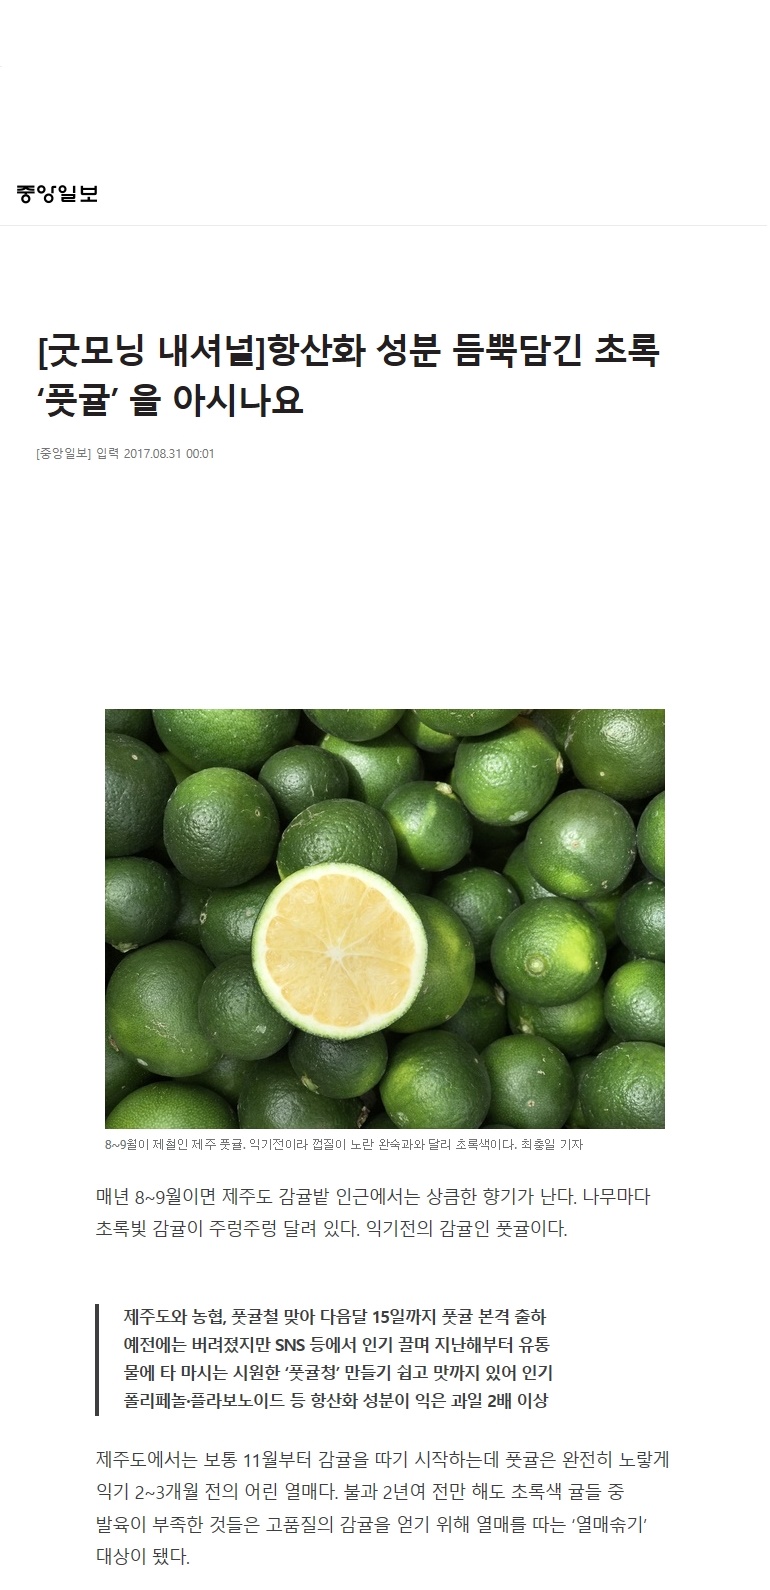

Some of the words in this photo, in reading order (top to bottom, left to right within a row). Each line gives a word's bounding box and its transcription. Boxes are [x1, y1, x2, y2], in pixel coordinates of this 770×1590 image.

[16, 184, 98, 205] 중앙일보
[38, 333, 144, 371] [굿모닝
[159, 333, 367, 371] 내셔널]항산화
[375, 333, 442, 368] 성분
[452, 333, 582, 369] 듬뿍담긴
[594, 333, 661, 368] 초록
[129, 383, 162, 417] 을
[173, 383, 304, 418] 아시나요
[36, 447, 91, 461] [중앙일보]
[96, 447, 119, 460] 입력
[123, 448, 181, 459] 2017.08.31
[186, 448, 214, 459] 00:01
[96, 1187, 129, 1206] 매년
[134, 1187, 216, 1206] 8~9월이면
[222, 1187, 273, 1206] 제주도
[278, 1187, 330, 1206] 감귤밭
[336, 1187, 421, 1206] 인근에서는
[426, 1187, 478, 1206] 상큼한
[482, 1187, 535, 1206] 향기가
[541, 1187, 577, 1206] 난다.
[583, 1187, 651, 1206] 나무마다
[123, 1308, 188, 1326] 제주도와
[191, 1308, 227, 1326] 농협,
[231, 1308, 279, 1326] 풋귤철
[284, 1308, 316, 1326] 맞아
[320, 1308, 369, 1326] 다음달
[372, 1308, 436, 1326] 15일까지
[441, 1308, 474, 1326] 풋귤
[477, 1308, 509, 1326] 본격
[514, 1308, 547, 1326] 출하
[123, 1336, 188, 1354] 예전에는
[192, 1336, 272, 1354] 버려졌지만
[275, 1338, 306, 1352] SNS
[309, 1336, 357, 1354] 등에서
[362, 1336, 393, 1354] 인기
[397, 1336, 429, 1354] 끌며
[434, 1336, 513, 1354] 지난해부터
[518, 1336, 551, 1354] 유통
